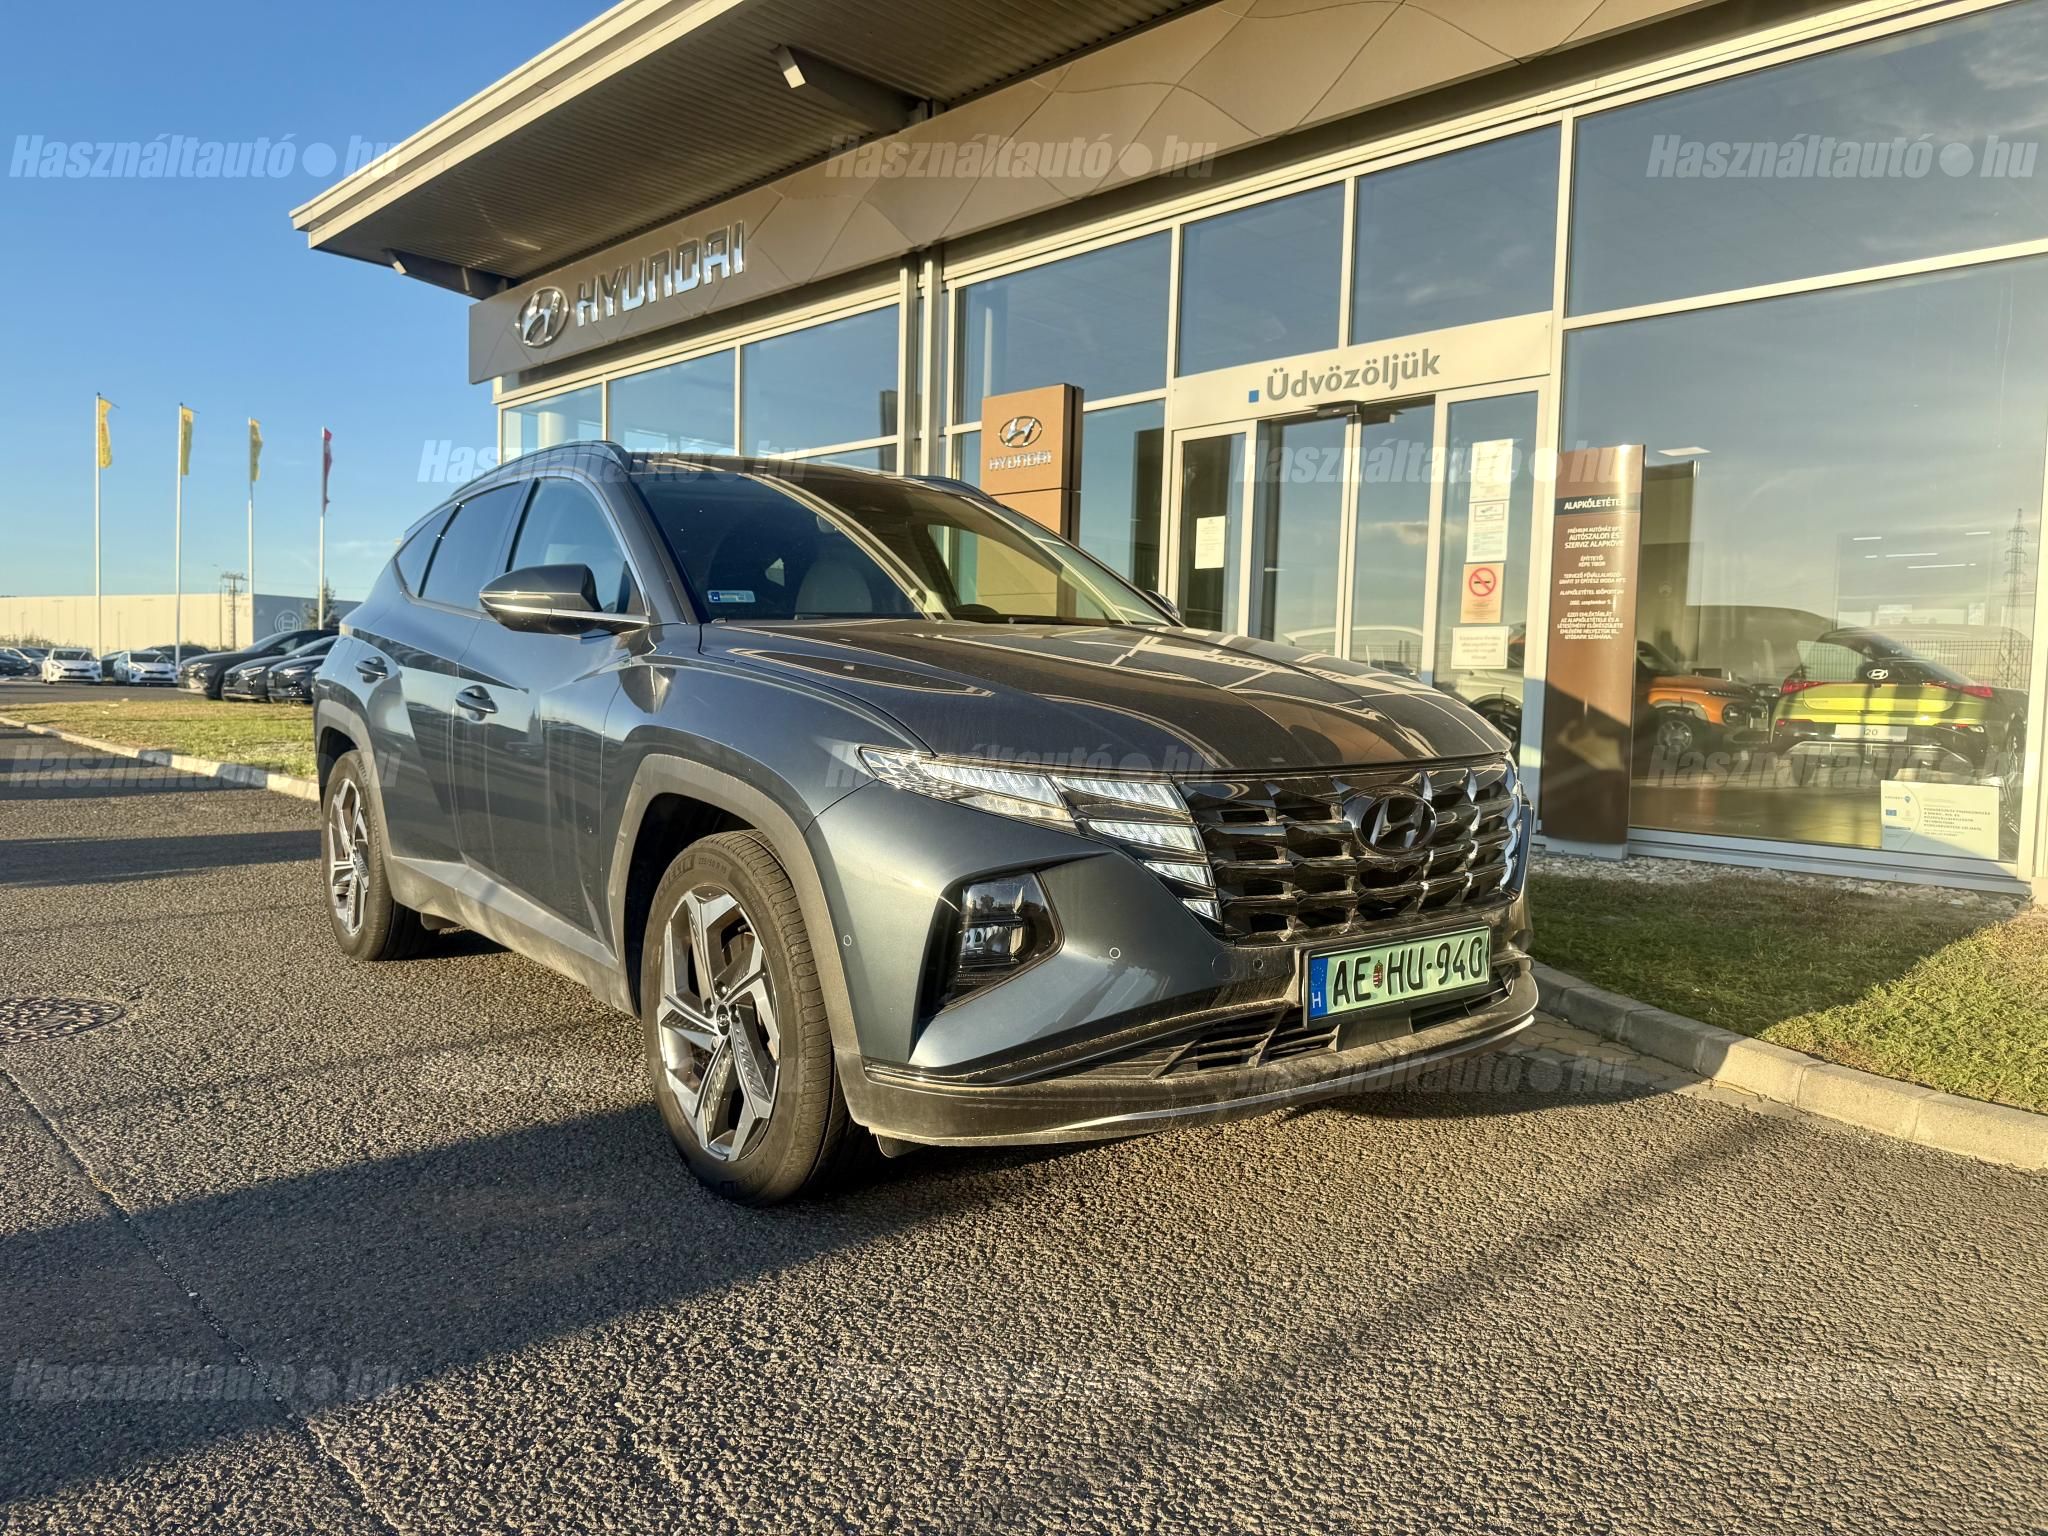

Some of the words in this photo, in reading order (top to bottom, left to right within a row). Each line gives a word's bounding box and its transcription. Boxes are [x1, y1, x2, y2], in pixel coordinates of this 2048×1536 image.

[576, 220, 745, 327] HYUNDAI
[1267, 348, 1440, 401] Üdvözöljük
[989, 450, 1052, 471] HYUNDAI
[1312, 991, 1322, 1009] H
[1333, 955, 1371, 1006] AE
